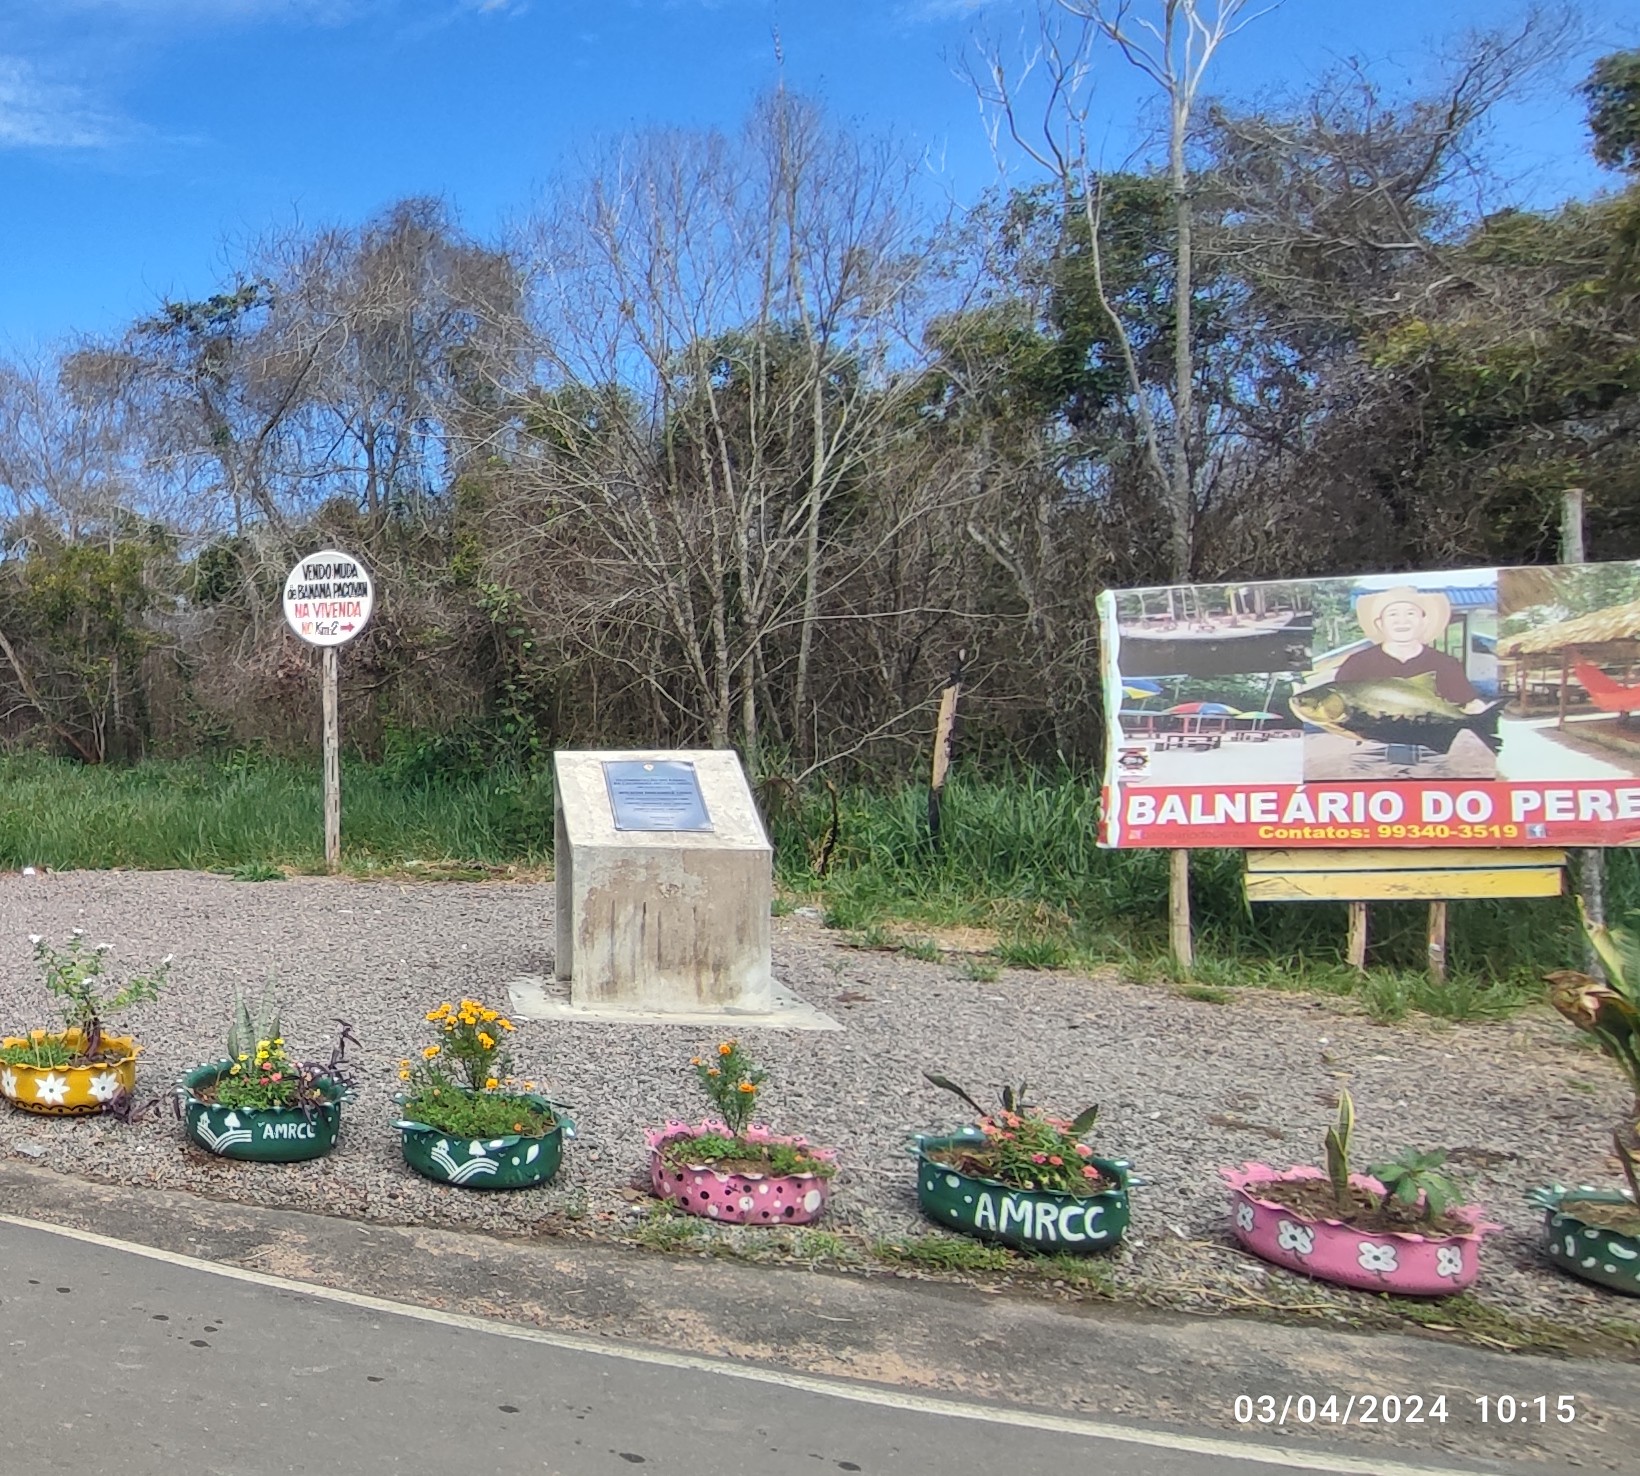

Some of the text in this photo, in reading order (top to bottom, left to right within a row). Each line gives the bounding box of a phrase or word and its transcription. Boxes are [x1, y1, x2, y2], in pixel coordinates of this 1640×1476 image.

[302, 563, 358, 581] VENDO MUDA
[298, 583, 332, 600] BANANA
[333, 581, 368, 598] PACOVAN
[295, 601, 362, 618] NA VIVENDA
[1127, 785, 1404, 826] BALNEÁRIO
[1421, 790, 1493, 823] DO
[1258, 824, 1518, 839] Contatos: 99340-3519
[974, 1192, 1108, 1242] AMRCC
